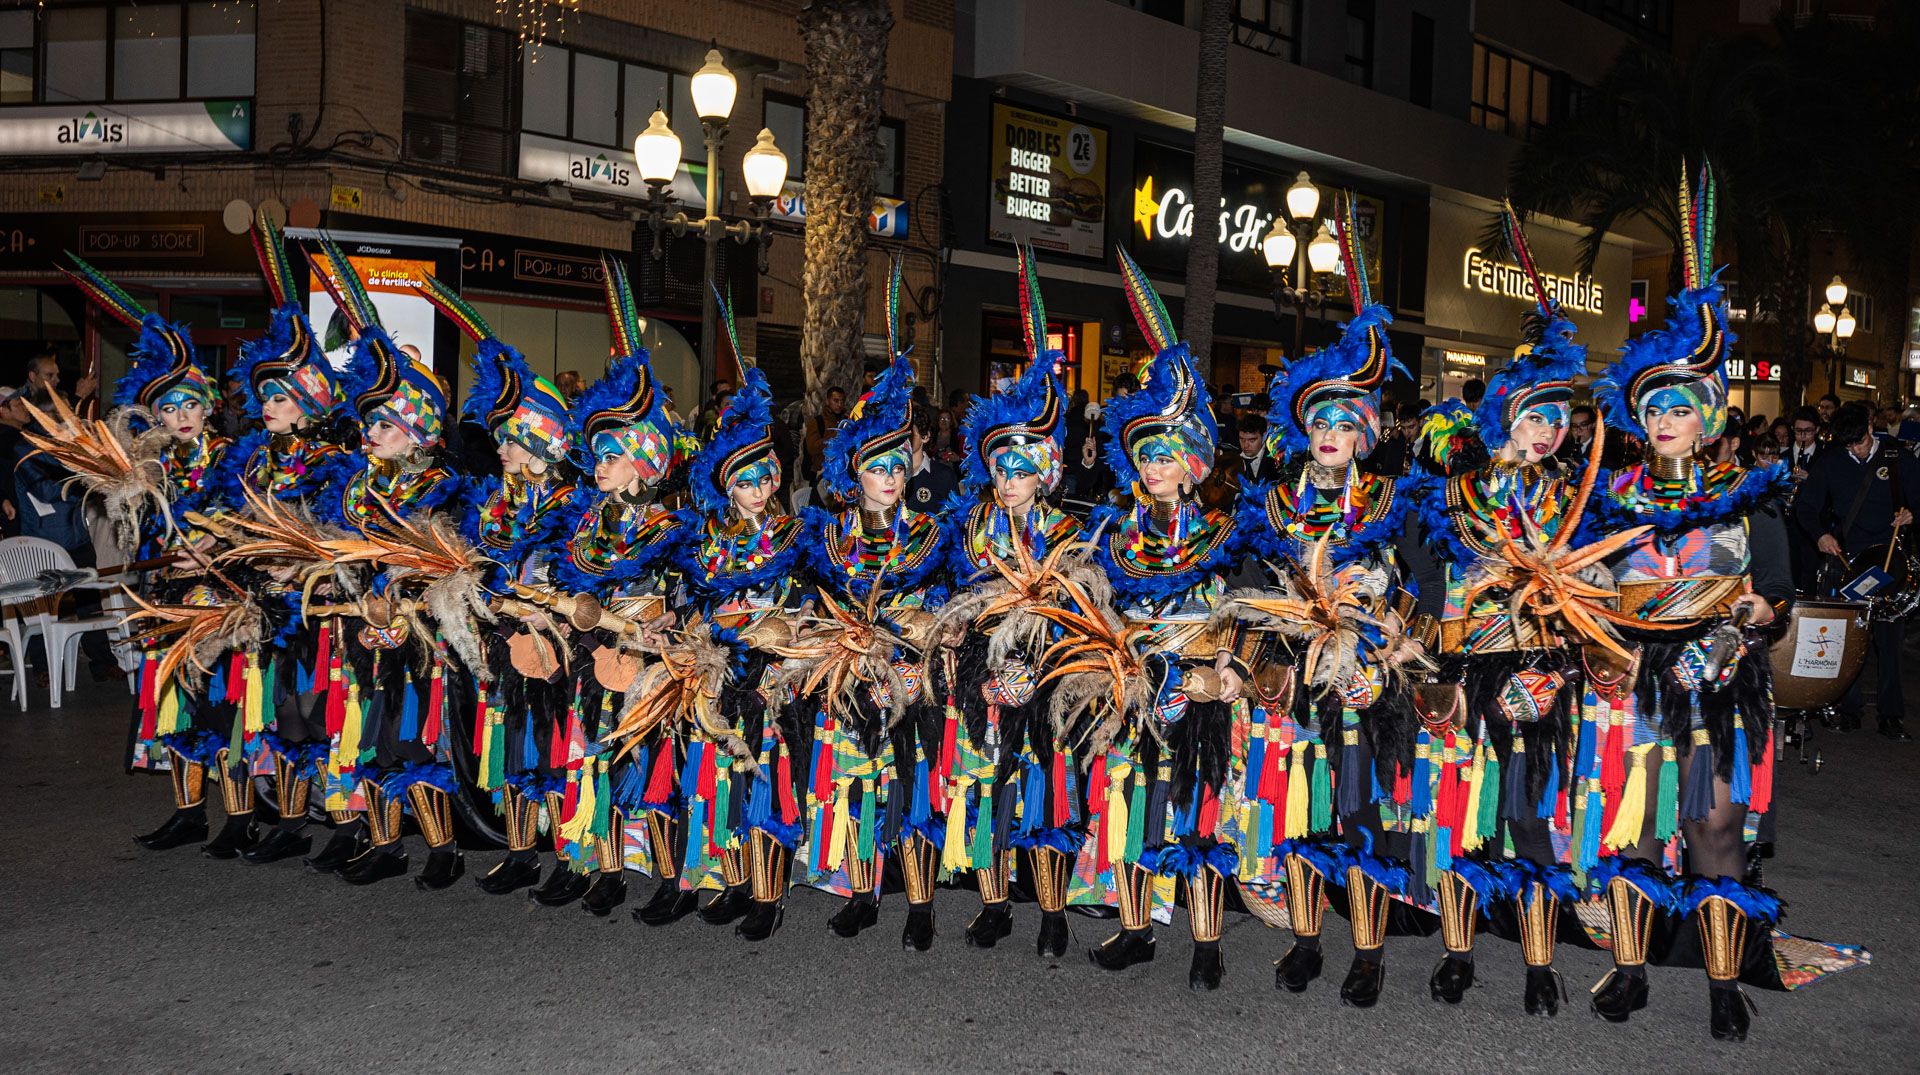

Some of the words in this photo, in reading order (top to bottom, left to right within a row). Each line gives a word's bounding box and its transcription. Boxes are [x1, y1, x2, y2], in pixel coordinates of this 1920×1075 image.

[1005, 123, 1061, 157] DOBLES
[1010, 147, 1051, 174] BIGGER
[1009, 171, 1051, 197] BETTER
[1006, 195, 1051, 222] BURGER
[1157, 188, 1230, 243] Ca's
[151, 233, 193, 249] STORE
[357, 245, 392, 255] JCDecaux
[368, 268, 379, 277] Tu
[381, 278, 422, 288] fertilidad
[1446, 351, 1486, 366] PARAFARMACIA
